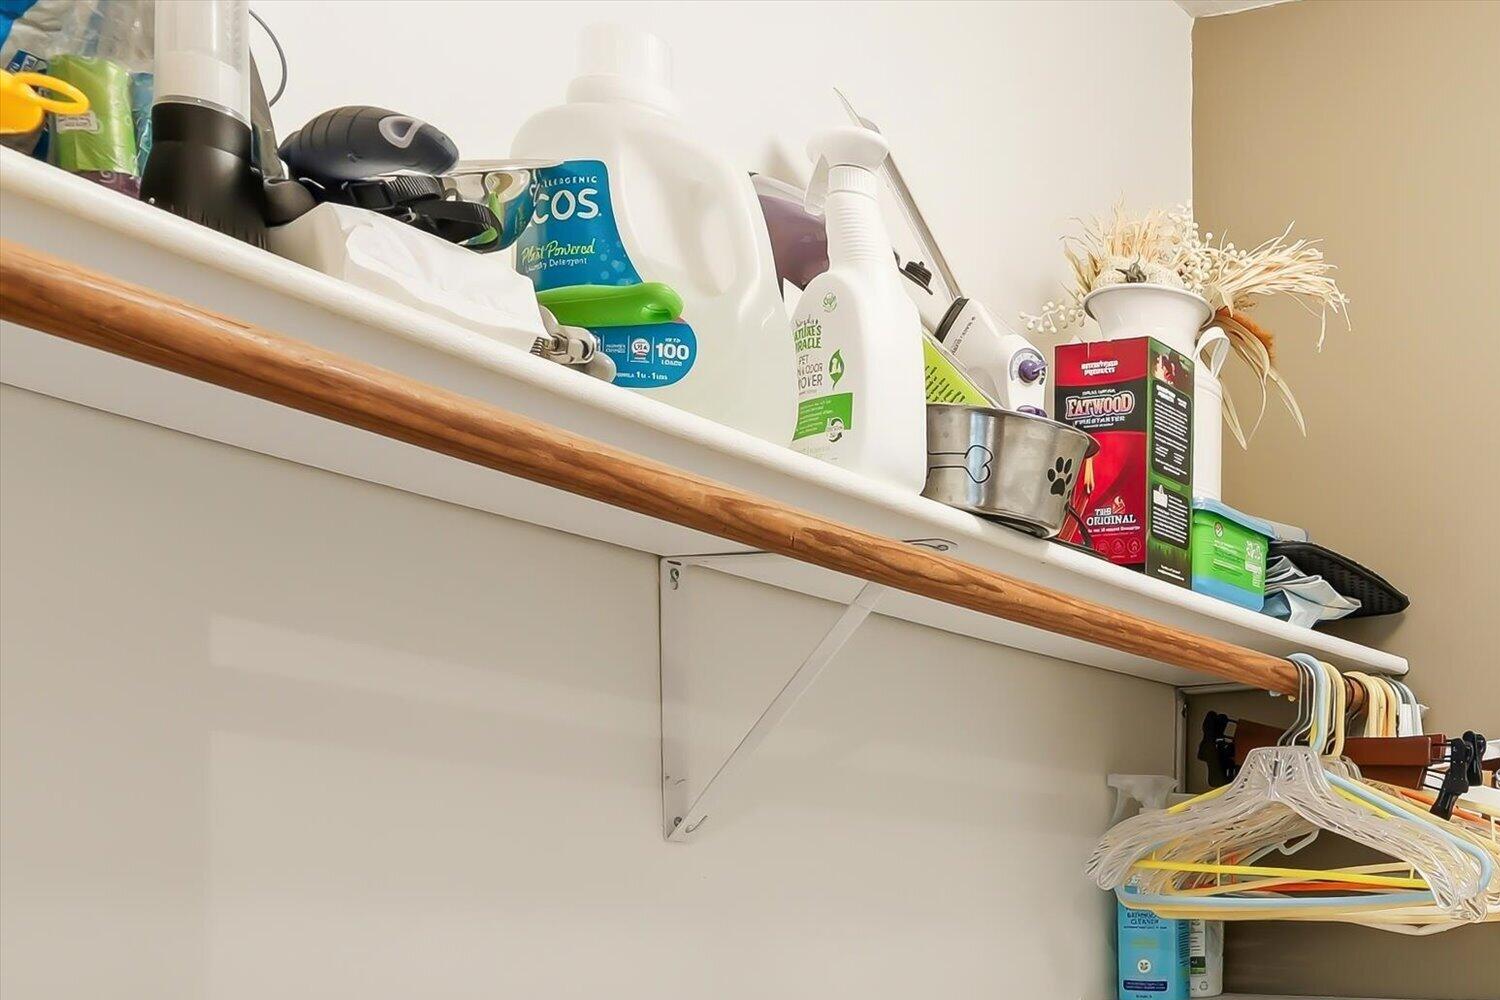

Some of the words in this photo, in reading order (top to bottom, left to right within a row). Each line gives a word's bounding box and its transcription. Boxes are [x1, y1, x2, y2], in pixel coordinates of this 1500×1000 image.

[532, 188, 599, 224] COS
[545, 237, 596, 258] Powered
[656, 342, 690, 360] 100
[1067, 393, 1133, 418] FATWOOD
[1086, 514, 1137, 526] ORIGINAL
